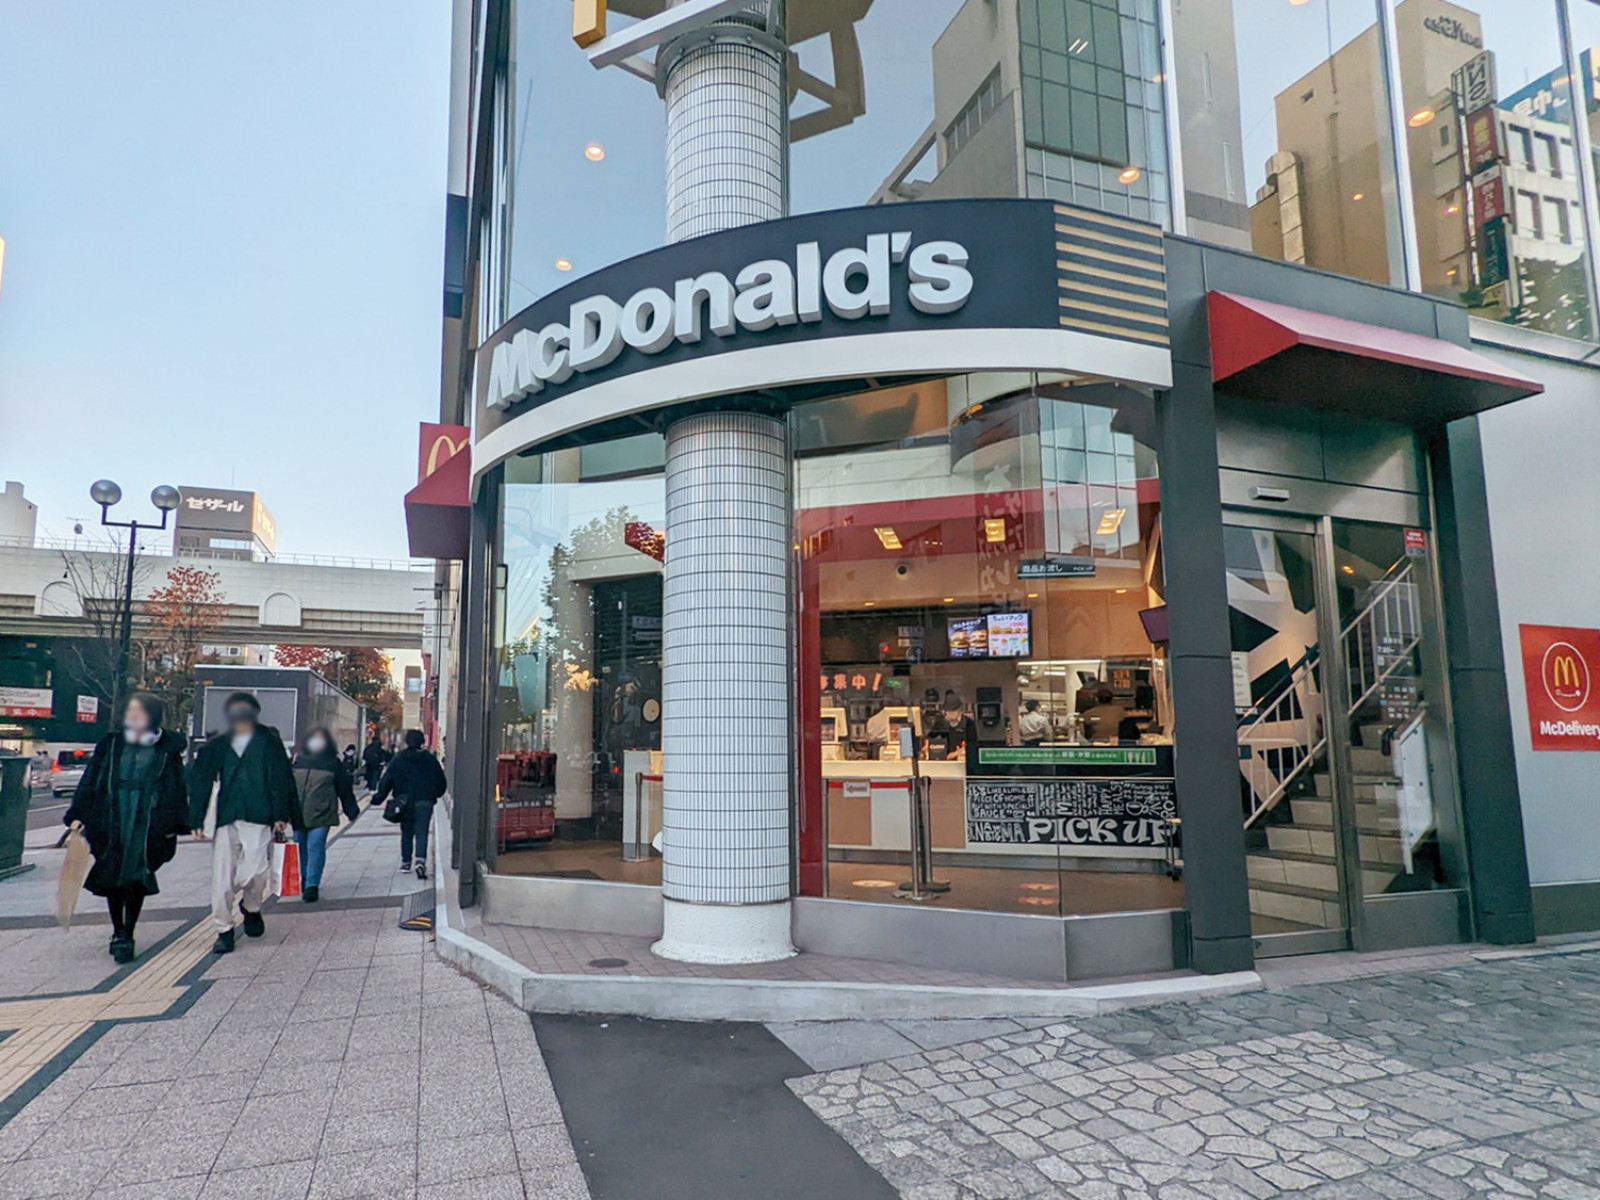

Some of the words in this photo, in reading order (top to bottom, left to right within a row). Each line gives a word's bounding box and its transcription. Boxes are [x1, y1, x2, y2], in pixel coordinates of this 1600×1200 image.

[486, 230, 974, 412] McDonald's
[186, 496, 245, 513] セザール
[993, 794, 1004, 803] OF
[1026, 817, 1118, 844] PICK
[1122, 818, 1178, 846] UP
